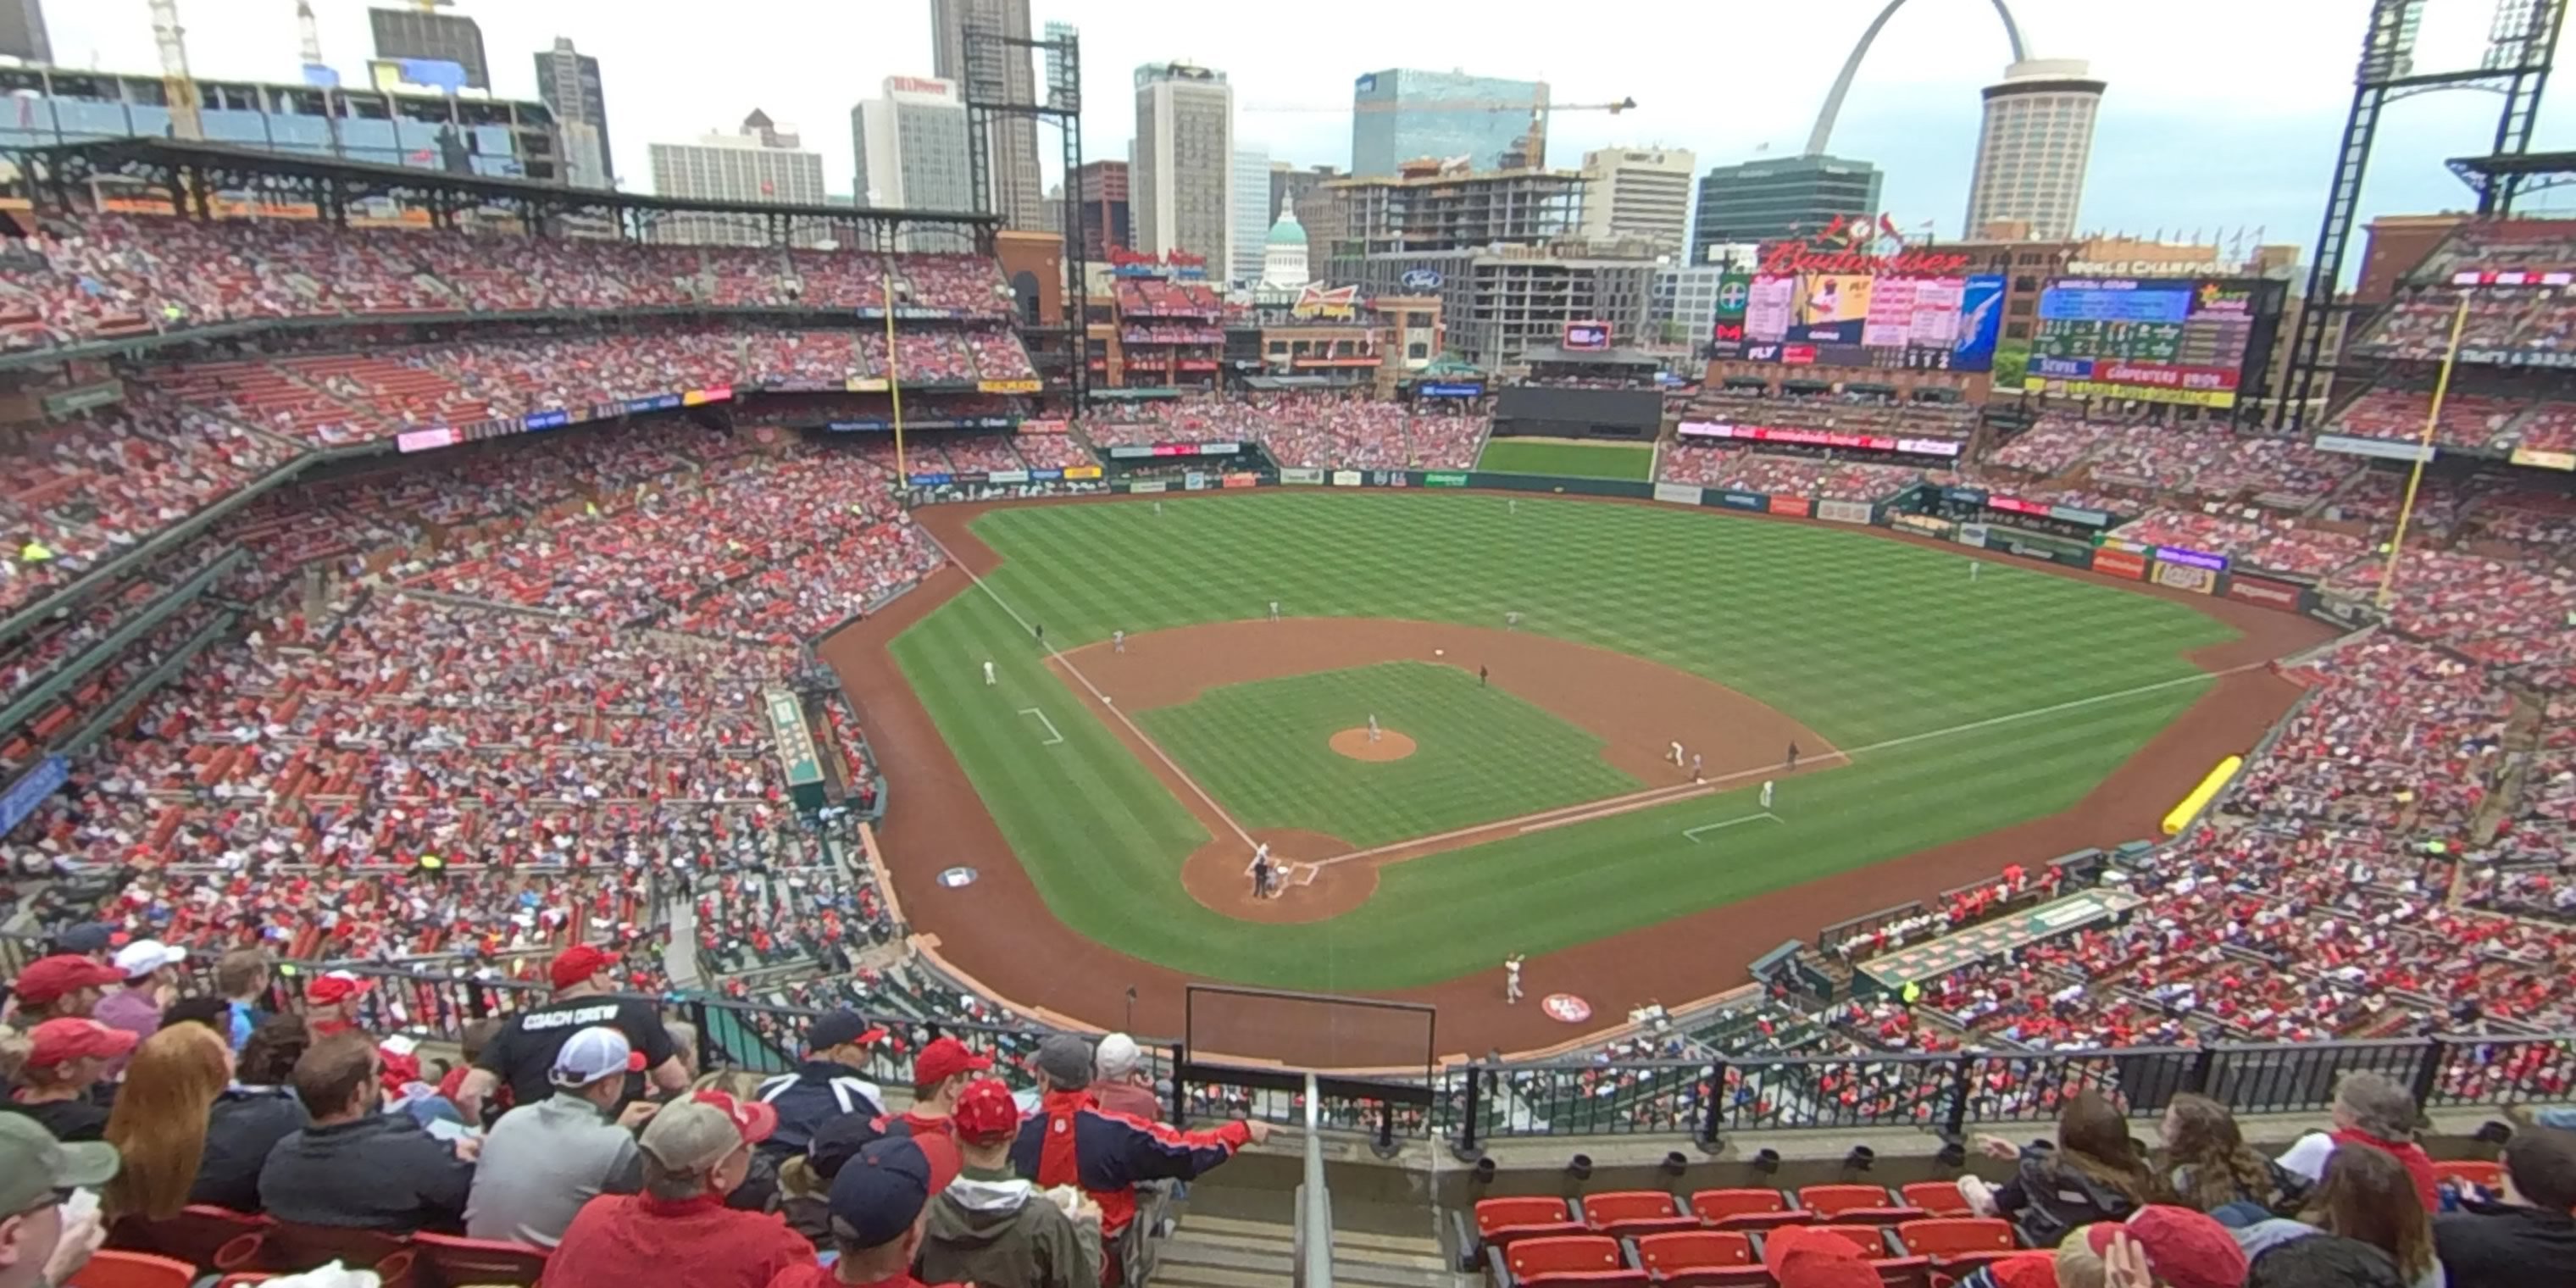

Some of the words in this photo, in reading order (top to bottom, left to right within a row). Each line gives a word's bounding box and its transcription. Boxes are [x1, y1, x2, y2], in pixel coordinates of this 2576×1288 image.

[1762, 241, 1968, 272] Budweiser
[1748, 346, 1777, 360] FLY
[523, 1011, 573, 1030] COACH
[574, 1004, 619, 1023] DREW
